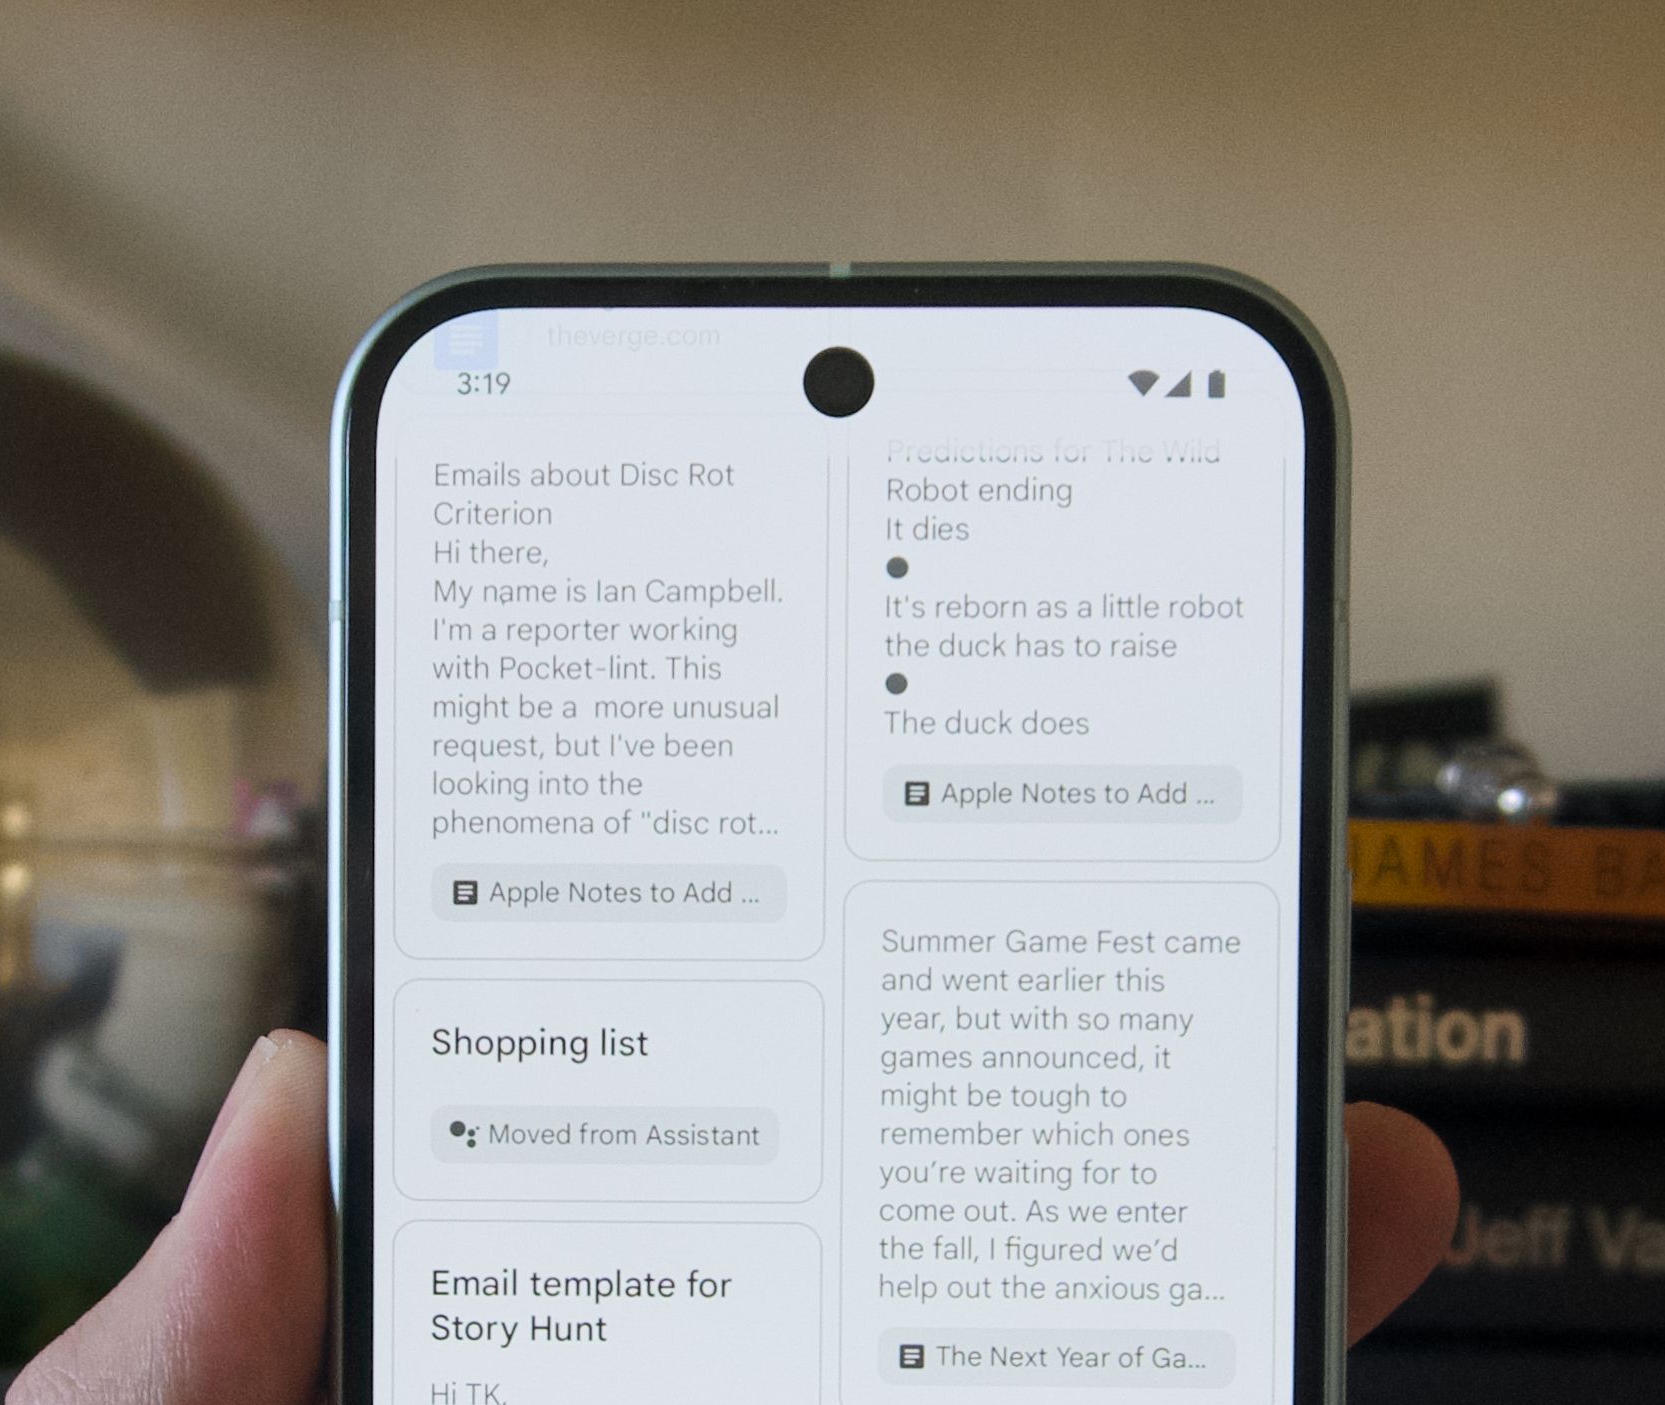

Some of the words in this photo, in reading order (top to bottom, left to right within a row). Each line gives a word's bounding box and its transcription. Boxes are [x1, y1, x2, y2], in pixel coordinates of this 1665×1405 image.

[547, 322, 721, 352] theverge.com
[455, 370, 513, 396] 3:19
[886, 438, 1044, 465] Predictions
[1053, 437, 1090, 464] for
[1102, 438, 1154, 464] The
[1163, 438, 1222, 465] Wild
[434, 461, 522, 488] Emails
[529, 461, 611, 488] about
[620, 460, 679, 488] Disc
[688, 462, 735, 488] Rot
[886, 476, 969, 503] Robot
[977, 475, 1073, 510] ending
[433, 499, 553, 527] Criterion
[885, 516, 904, 542] It
[911, 514, 971, 542] dies
[433, 538, 461, 565] Hi
[468, 538, 549, 569] there,
[433, 578, 474, 610] My
[482, 584, 558, 606] name
[566, 577, 588, 604] is
[596, 579, 637, 604] Ian
[644, 577, 783, 609] Campbell.
[433, 617, 473, 642] I'm
[481, 622, 497, 642] a
[506, 619, 621, 648] reporter
[628, 615, 738, 649] working
[884, 631, 931, 658] the
[938, 631, 1007, 659] duck
[1015, 631, 1065, 659] has
[1073, 635, 1102, 659] to
[1110, 631, 1178, 659] raise
[432, 654, 490, 681] with
[499, 654, 656, 681] Pocket-lint.
[665, 654, 722, 681] This
[883, 708, 937, 736] The
[944, 708, 1013, 736] duck
[1020, 709, 1090, 736] does
[881, 928, 997, 954] Summer
[1004, 928, 1088, 955] Game
[1096, 929, 1156, 955] Fest
[1163, 934, 1242, 955] came
[881, 966, 933, 992] and
[941, 969, 1009, 993] went
[1016, 966, 1106, 993] earlier
[1114, 966, 1166, 994] this
[1346, 991, 1528, 1067] ation
[431, 1026, 589, 1065] Shopping
[600, 1027, 649, 1058] list
[880, 1049, 973, 1076] games
[981, 1043, 1145, 1073] announced,
[1154, 1043, 1171, 1070] it
[488, 1122, 572, 1146] Moved
[578, 1121, 638, 1146] from
[645, 1122, 760, 1147] Assistant
[880, 1119, 1024, 1147] remember
[1031, 1120, 1115, 1147] which
[1122, 1127, 1191, 1148] ones
[1449, 1207, 1568, 1267] Jeff
[432, 1267, 518, 1297] Email
[529, 1268, 676, 1305] template
[686, 1268, 733, 1299] for
[431, 1313, 519, 1349] Story
[530, 1314, 607, 1343] Hunt
